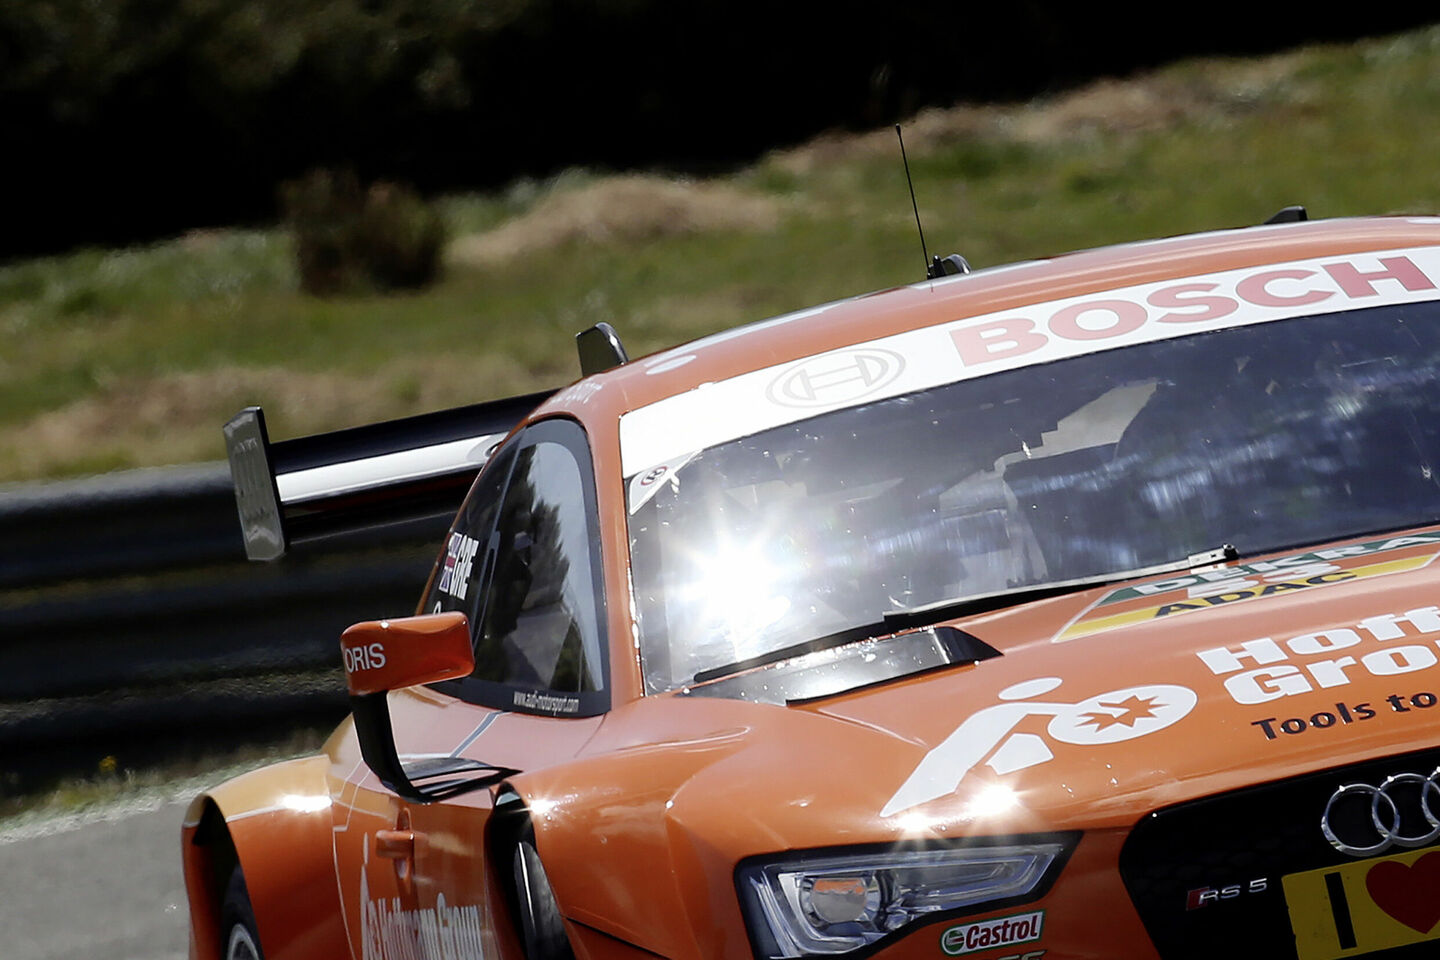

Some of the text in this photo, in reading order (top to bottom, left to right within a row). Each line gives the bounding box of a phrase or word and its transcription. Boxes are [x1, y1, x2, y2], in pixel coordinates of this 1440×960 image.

[948, 256, 1438, 367] BOSCH
[1153, 571, 1359, 618] ADAC
[344, 642, 387, 674] ORIS
[1251, 701, 1377, 741] Tools
[1385, 690, 1439, 713] to
[965, 913, 1039, 950] Castrol
[1323, 871, 1358, 951] I
